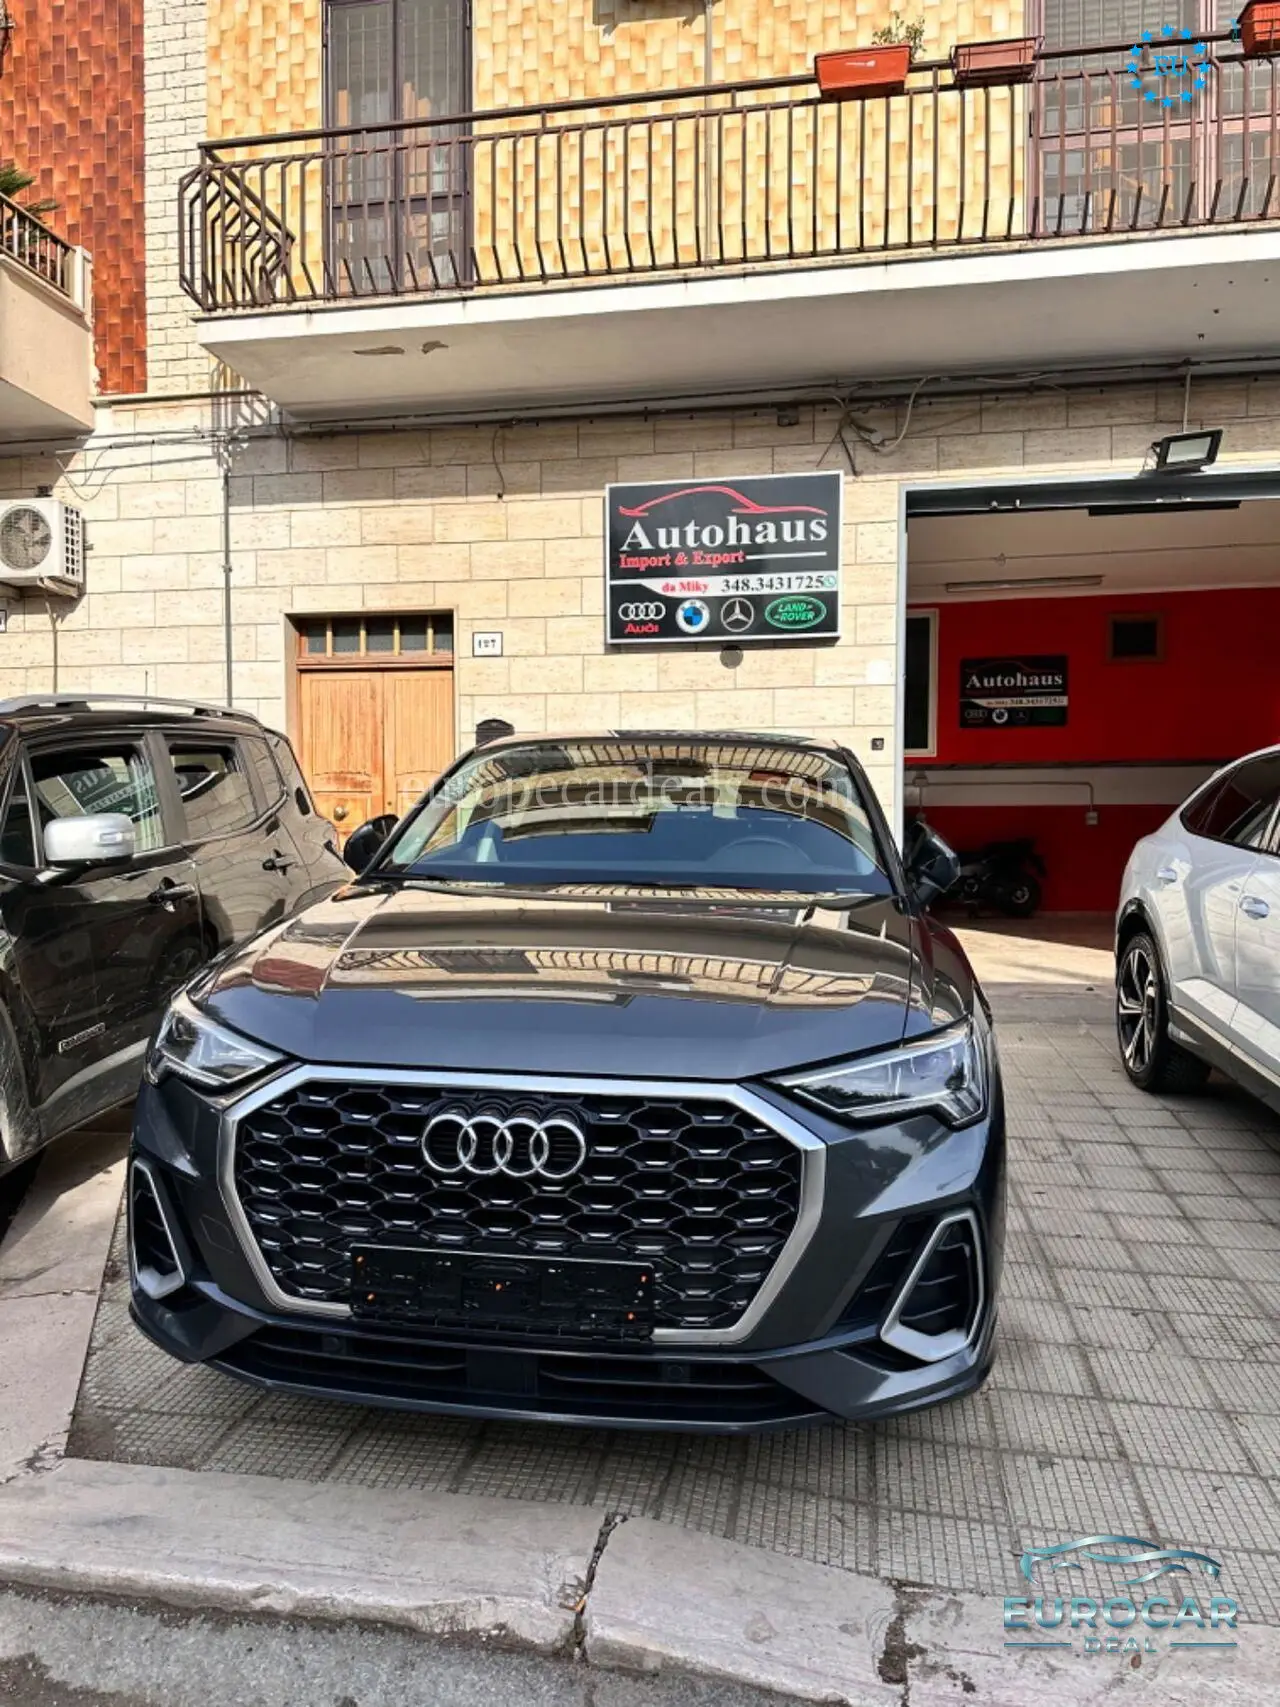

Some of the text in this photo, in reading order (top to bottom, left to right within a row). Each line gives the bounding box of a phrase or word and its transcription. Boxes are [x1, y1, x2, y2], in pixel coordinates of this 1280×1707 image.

[619, 515, 828, 551] Autohaus
[619, 550, 744, 571] Import & Export
[661, 575, 825, 594] da Miky 348.3431725
[624, 622, 660, 634] Audi
[966, 671, 1063, 689] Autohaus
